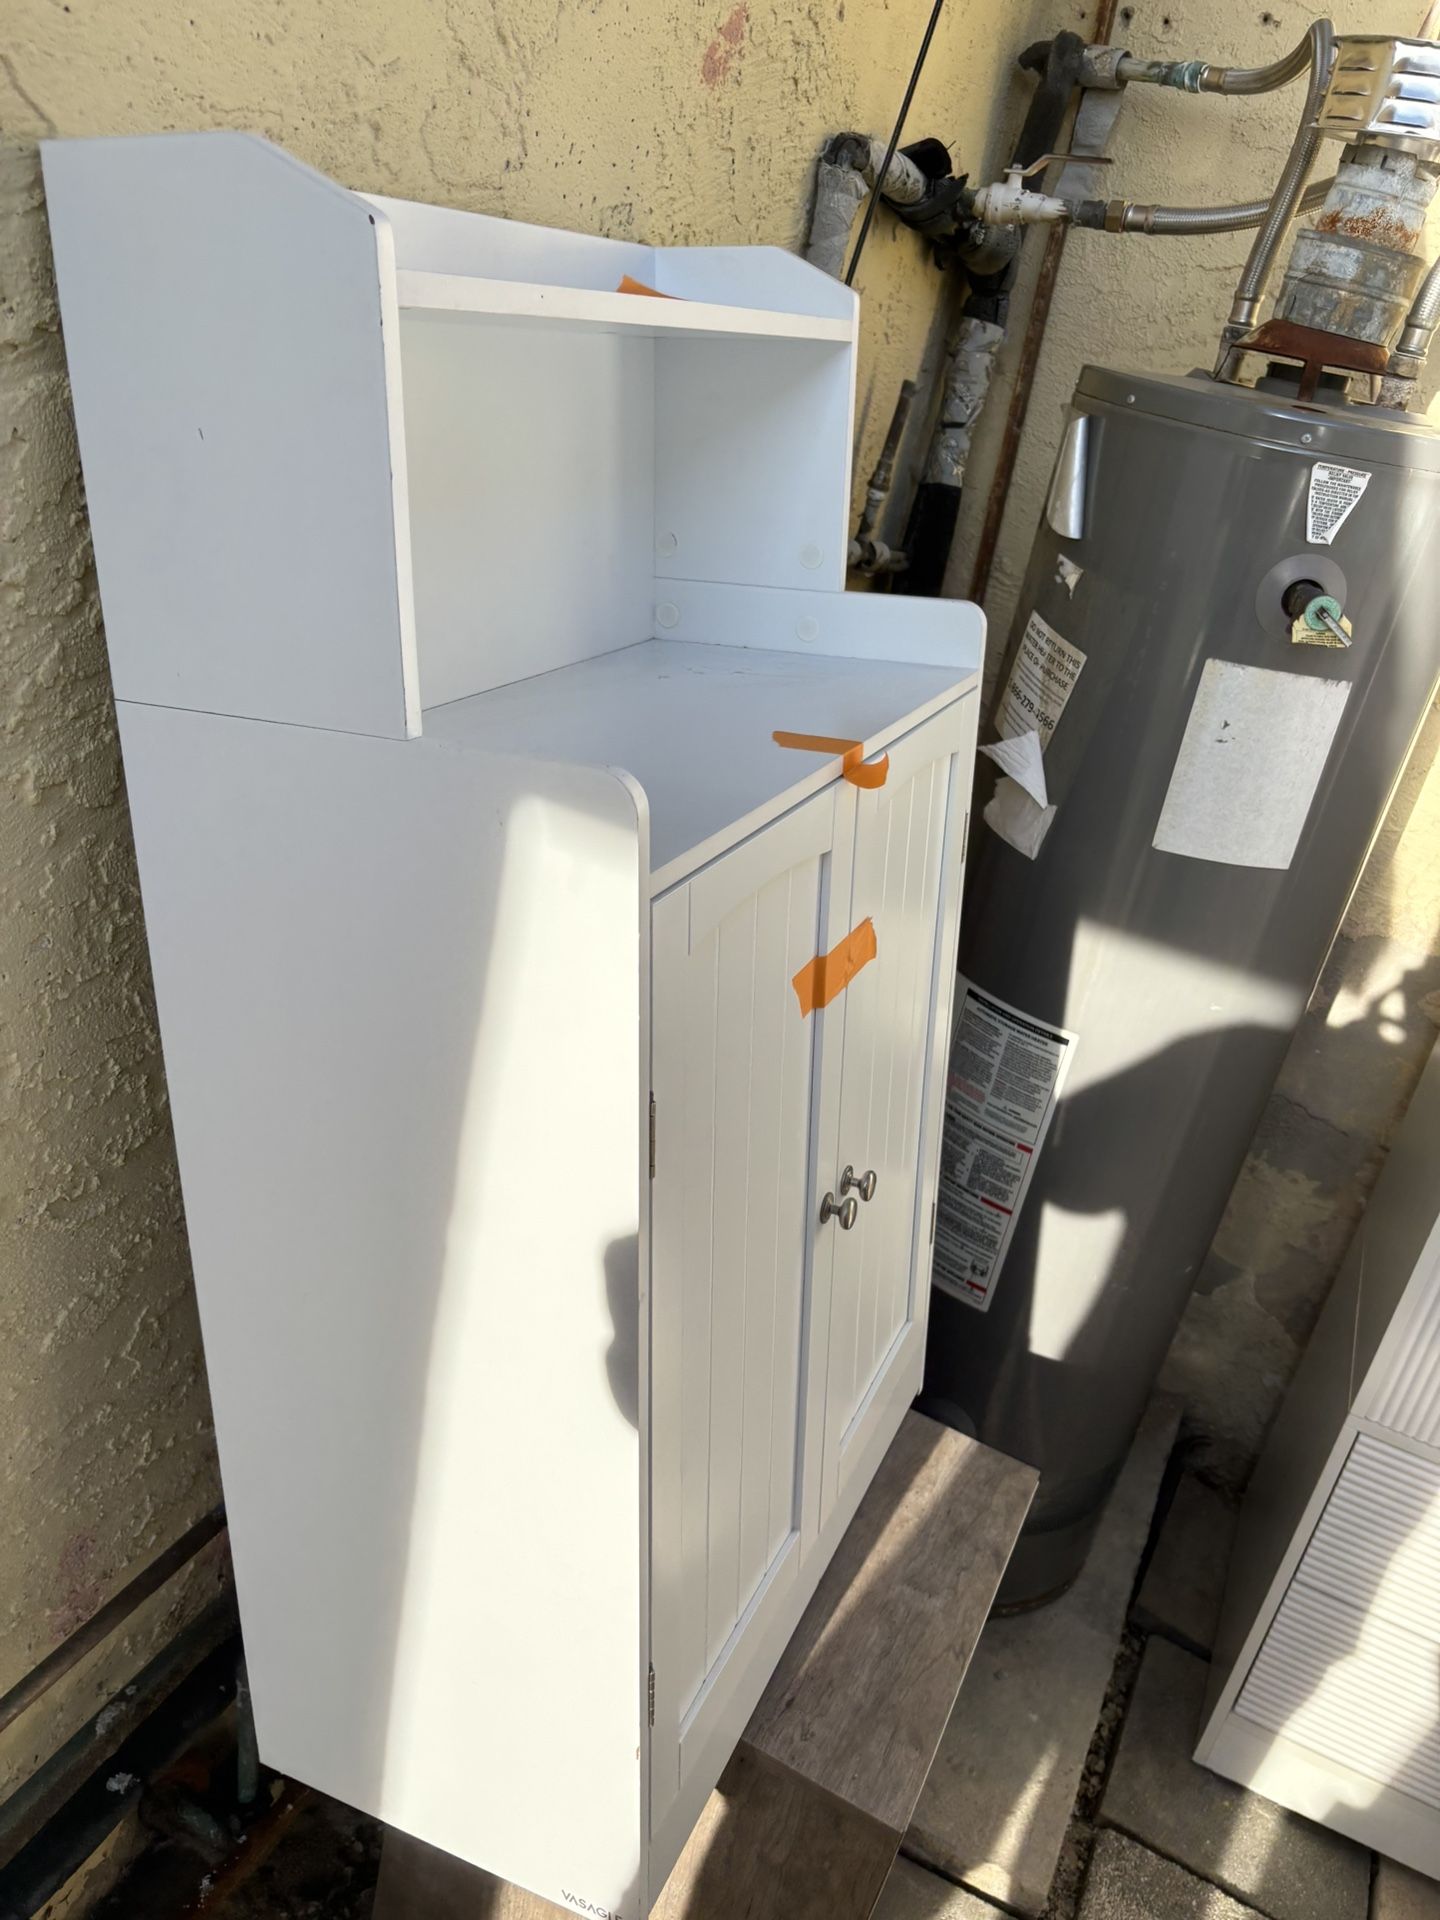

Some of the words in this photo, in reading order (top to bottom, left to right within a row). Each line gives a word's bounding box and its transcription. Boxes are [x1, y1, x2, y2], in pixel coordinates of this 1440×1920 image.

[1030, 620, 1036, 631] DO
[1036, 627, 1046, 640] NOT
[1045, 635, 1066, 660] RETURN
[1066, 654, 1082, 669] THIS
[1039, 664, 1069, 691] PURCHASE
[1056, 661, 1065, 673] TO
[1064, 667, 1077, 681] THE
